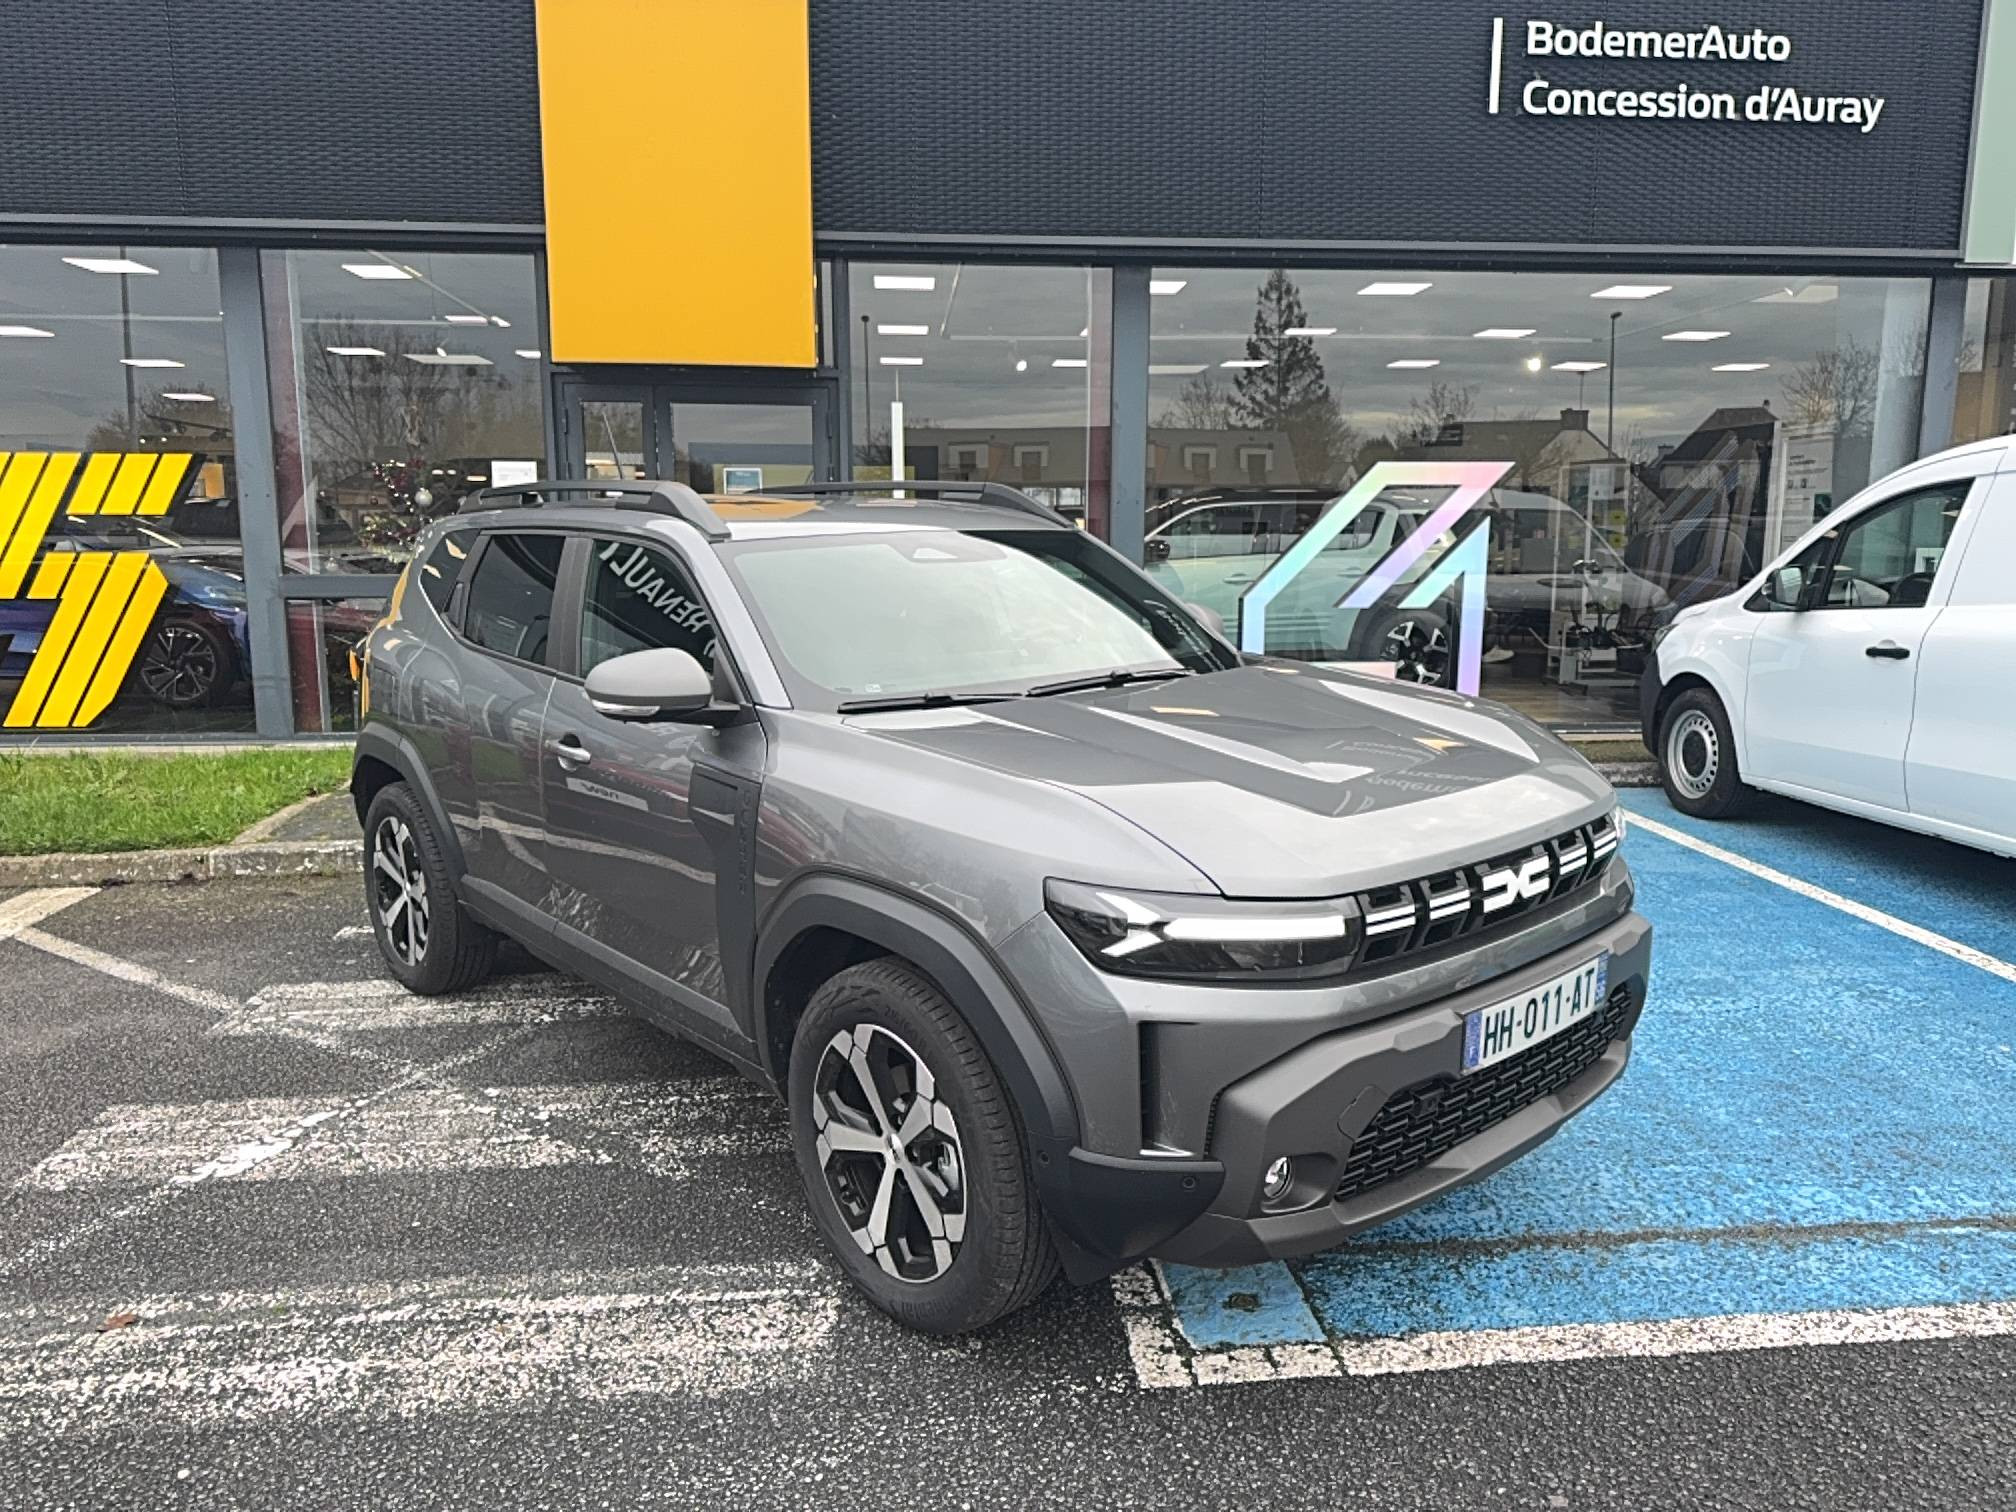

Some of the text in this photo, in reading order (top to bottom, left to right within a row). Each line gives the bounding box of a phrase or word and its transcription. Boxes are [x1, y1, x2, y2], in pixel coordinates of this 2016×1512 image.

[1526, 21, 1791, 62] BodemerAuto
[1522, 80, 1884, 133] Concession d'Auray
[1482, 967, 1595, 1059] HH-011-AT
